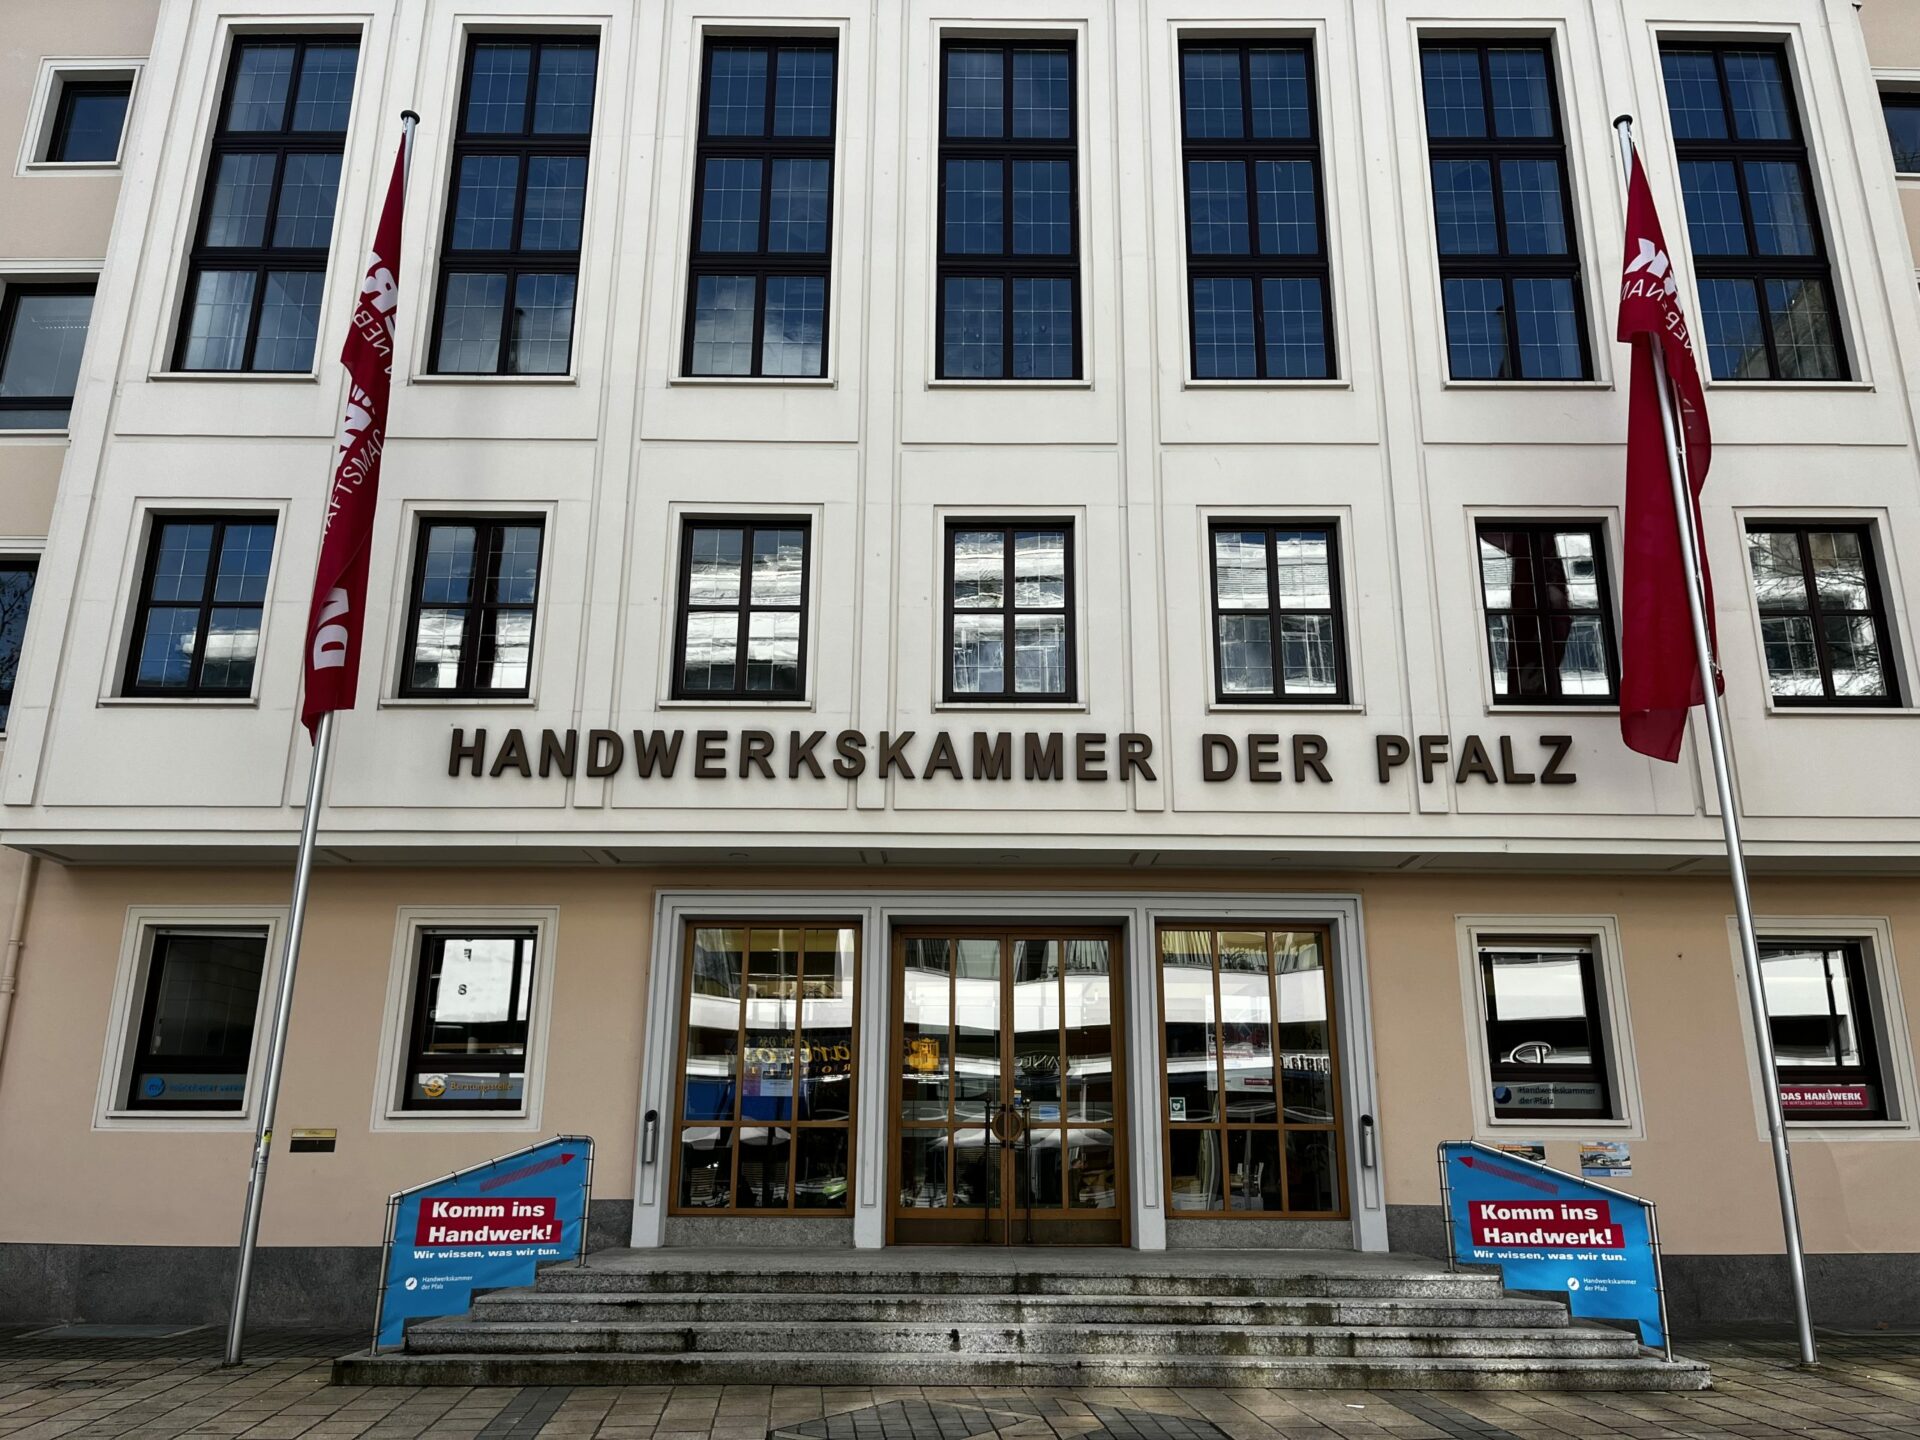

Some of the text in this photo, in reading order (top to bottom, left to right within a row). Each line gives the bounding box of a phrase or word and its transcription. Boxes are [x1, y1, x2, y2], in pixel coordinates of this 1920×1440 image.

[447, 728, 1577, 785] HANDWERKSKAMMER DER PFALZ
[1517, 1086, 1596, 1095] Handwerkskammer
[1780, 1089, 1862, 1100] DAS HANDWERK
[1519, 1097, 1554, 1105] der Pfalz
[432, 1201, 545, 1218] Komm ins
[1480, 1204, 1599, 1220] Komm ins
[428, 1224, 553, 1243] Handwerk!
[1483, 1227, 1613, 1245] Handwerk!
[413, 1250, 435, 1259] Wir
[438, 1249, 485, 1259] wissen,
[516, 1248, 536, 1256] wir
[1473, 1250, 1494, 1259] Wir
[1497, 1251, 1545, 1261] wissen,
[1577, 1252, 1599, 1261] wir
[1601, 1253, 1627, 1261] tun.
[422, 1275, 473, 1283] Handwerkskammer
